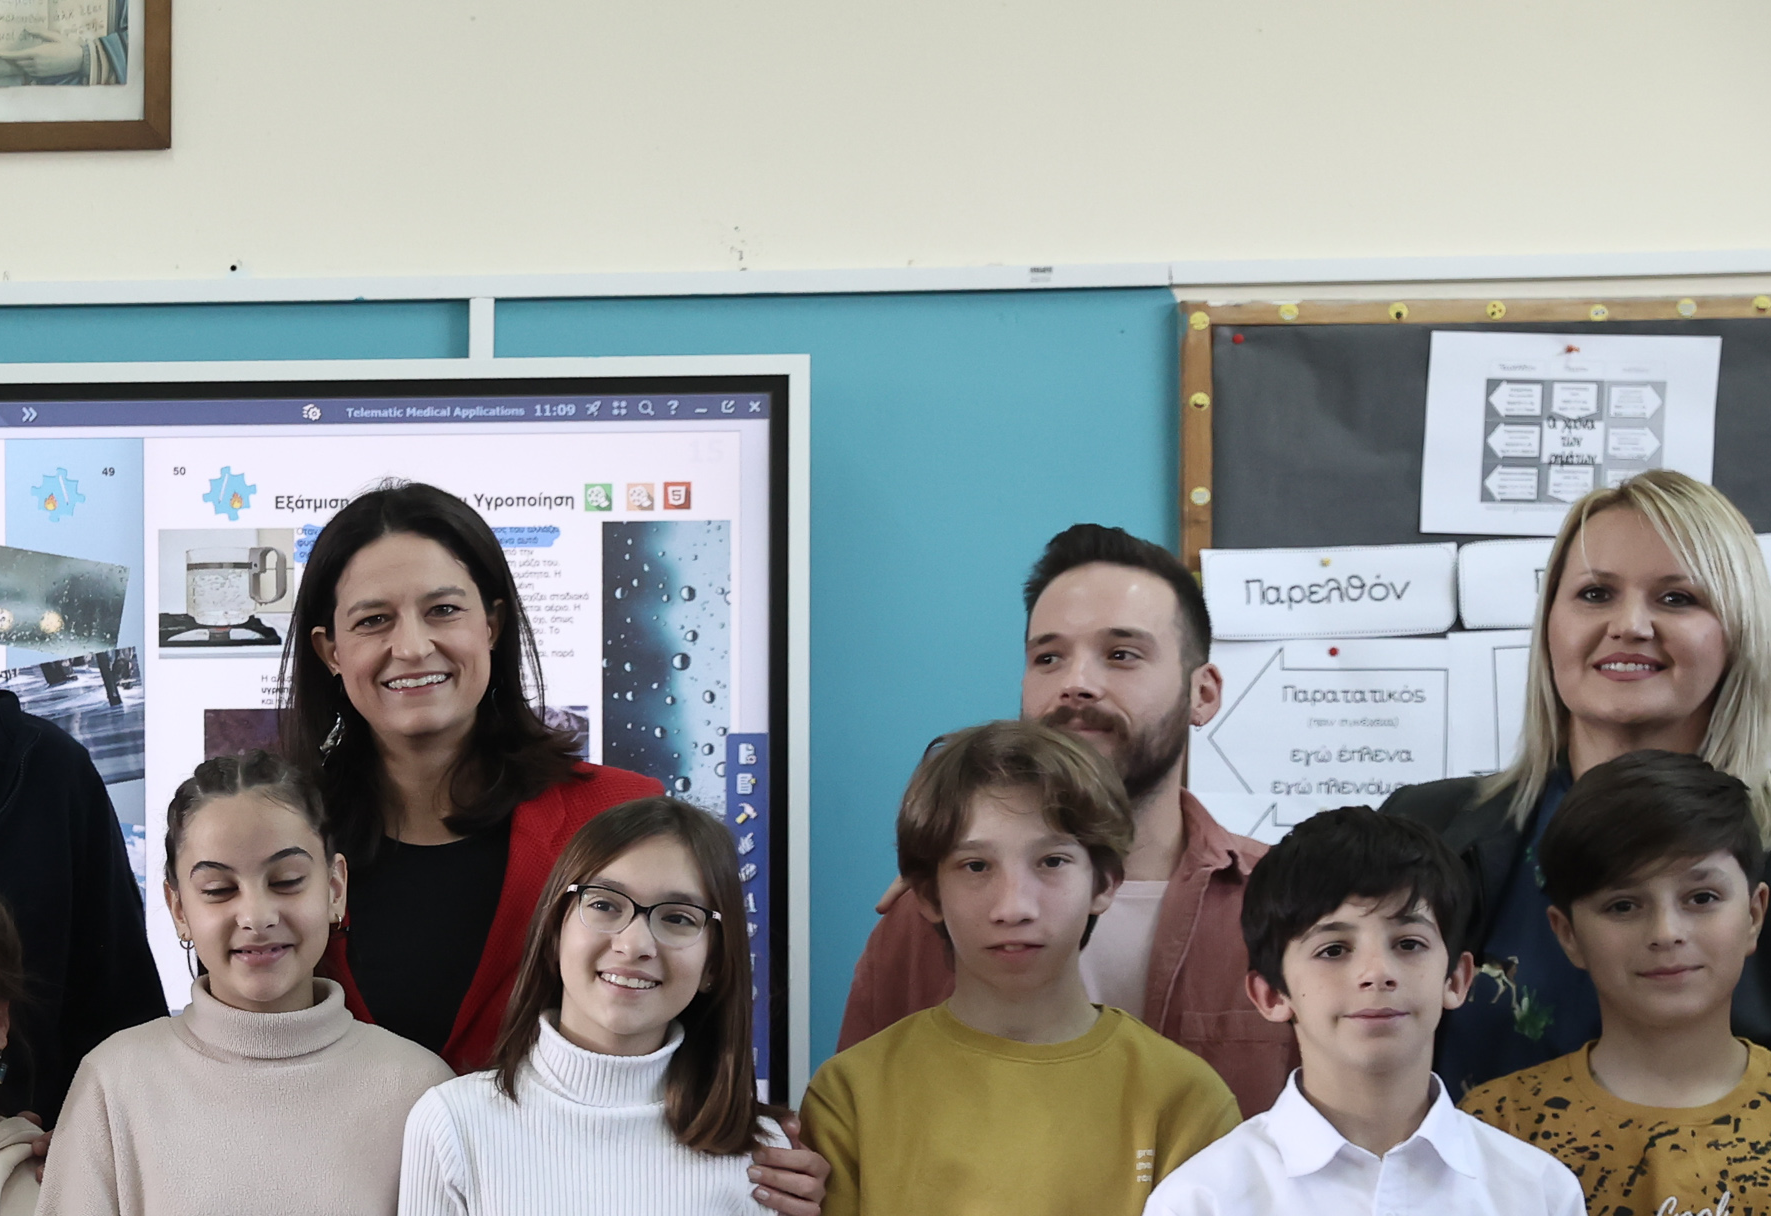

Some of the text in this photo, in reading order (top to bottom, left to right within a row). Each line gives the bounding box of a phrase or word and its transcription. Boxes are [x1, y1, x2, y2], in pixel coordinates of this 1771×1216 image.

[346, 405, 525, 419] Telematic Medical Applications
[534, 403, 576, 416] 11:09
[102, 467, 116, 477] 49
[173, 466, 187, 476] 50
[274, 494, 349, 513] Εξάτμιση
[473, 492, 575, 511] Υγροποίηση
[1243, 573, 1411, 611] Παρελθόν
[1281, 685, 1427, 707] Παρατατικός
[1289, 743, 1415, 767] εγώ έπλενα
[1270, 776, 1314, 796] εγώ
